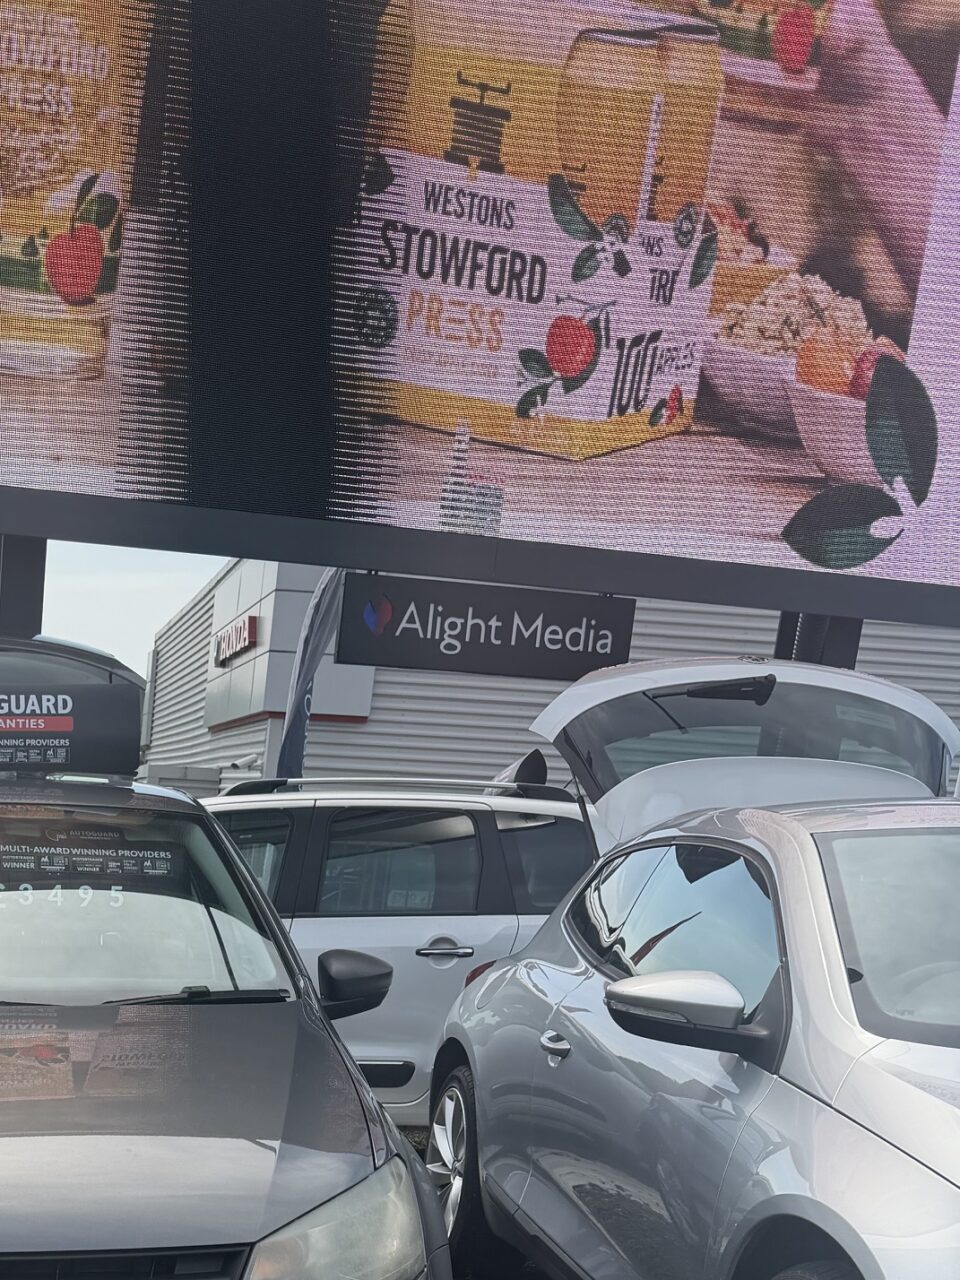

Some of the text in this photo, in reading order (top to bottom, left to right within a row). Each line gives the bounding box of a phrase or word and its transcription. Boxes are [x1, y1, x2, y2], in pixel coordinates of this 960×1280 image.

[423, 181, 516, 230] WESTONS
[378, 219, 547, 304] STOWFORD
[405, 288, 505, 352] PRESS
[395, 601, 613, 654] Alight Media
[0, 844, 172, 859] MULTI-AWARD WINNING PROVIDERS
[2, 861, 35, 870] WINNER
